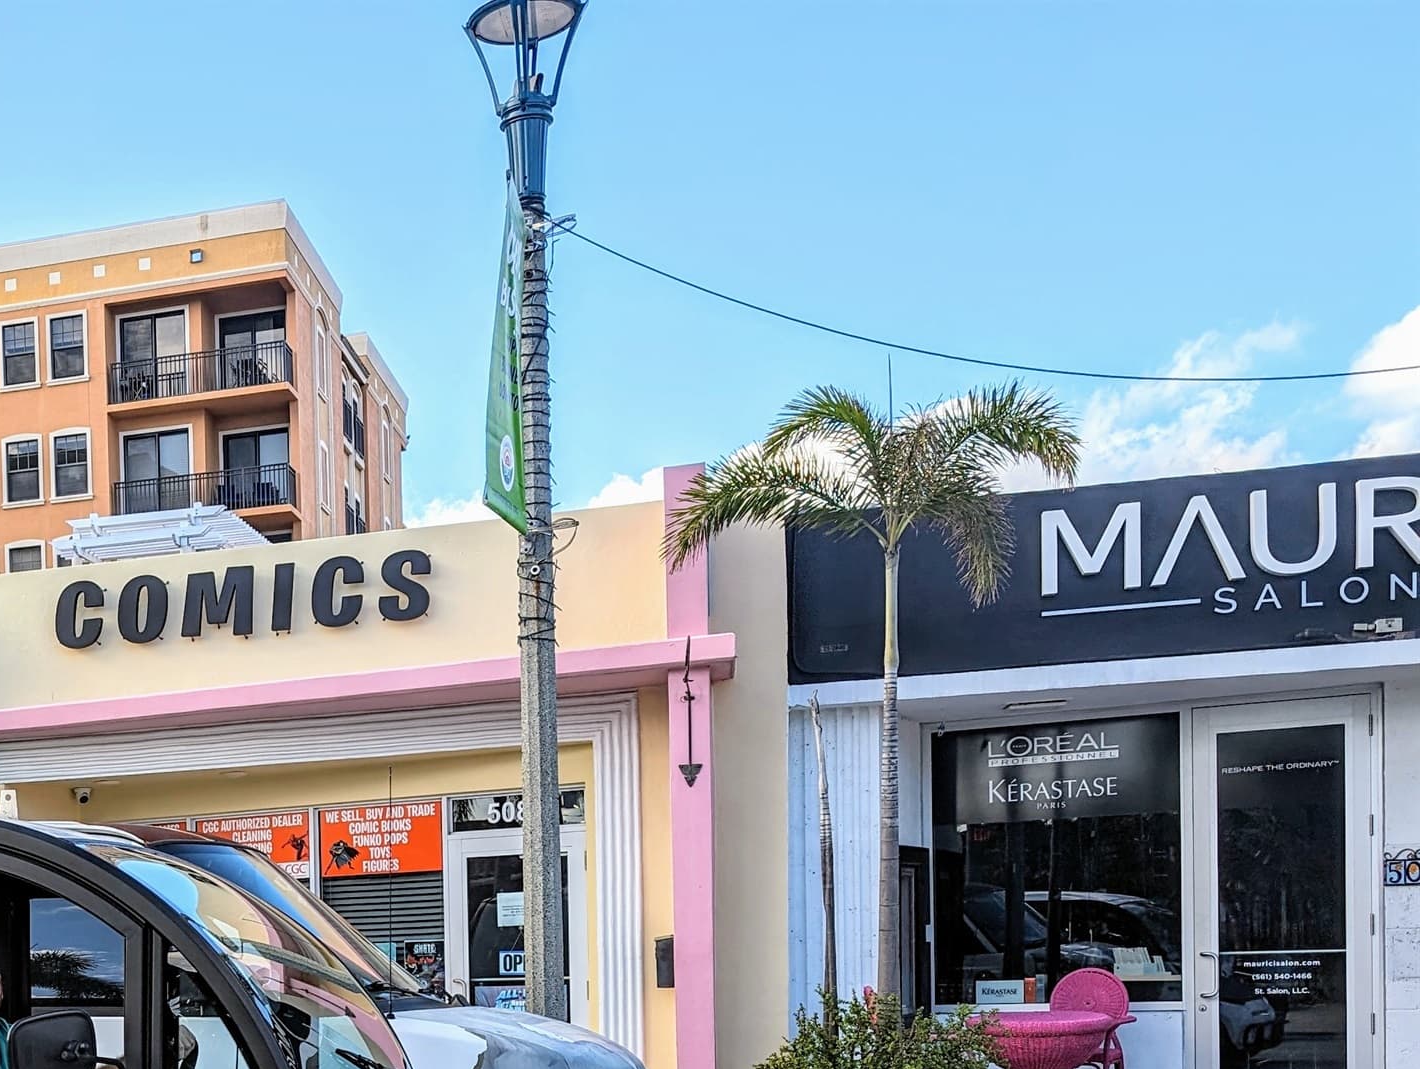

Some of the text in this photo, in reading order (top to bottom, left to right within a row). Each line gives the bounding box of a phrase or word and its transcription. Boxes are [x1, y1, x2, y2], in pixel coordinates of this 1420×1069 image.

[55, 550, 432, 649] COMICS
[1214, 571, 1419, 614] SALON
[988, 732, 1120, 758] L'ORÉAL
[989, 750, 1118, 766] PROFESSIONNEL
[1221, 765, 1264, 774] RESHAPE
[1266, 763, 1285, 771] THE
[988, 777, 1118, 804] KÉRASTASE
[325, 811, 340, 824] WE
[366, 808, 384, 821] BUY
[385, 806, 405, 819] AND
[406, 803, 436, 817] TRADE
[1036, 801, 1067, 810] PARIS
[202, 814, 303, 834] CGC AUTHORIZED DEALER
[348, 818, 412, 835] COMIC BOOKS
[232, 829, 273, 844] CLEANING
[353, 832, 409, 847] FUNKO POPS
[369, 846, 392, 859] TOYS
[362, 858, 400, 873] FIGURES
[503, 953, 526, 972] OP
[1243, 959, 1321, 968] mauricisalon.com
[1251, 973, 1273, 981] (561)
